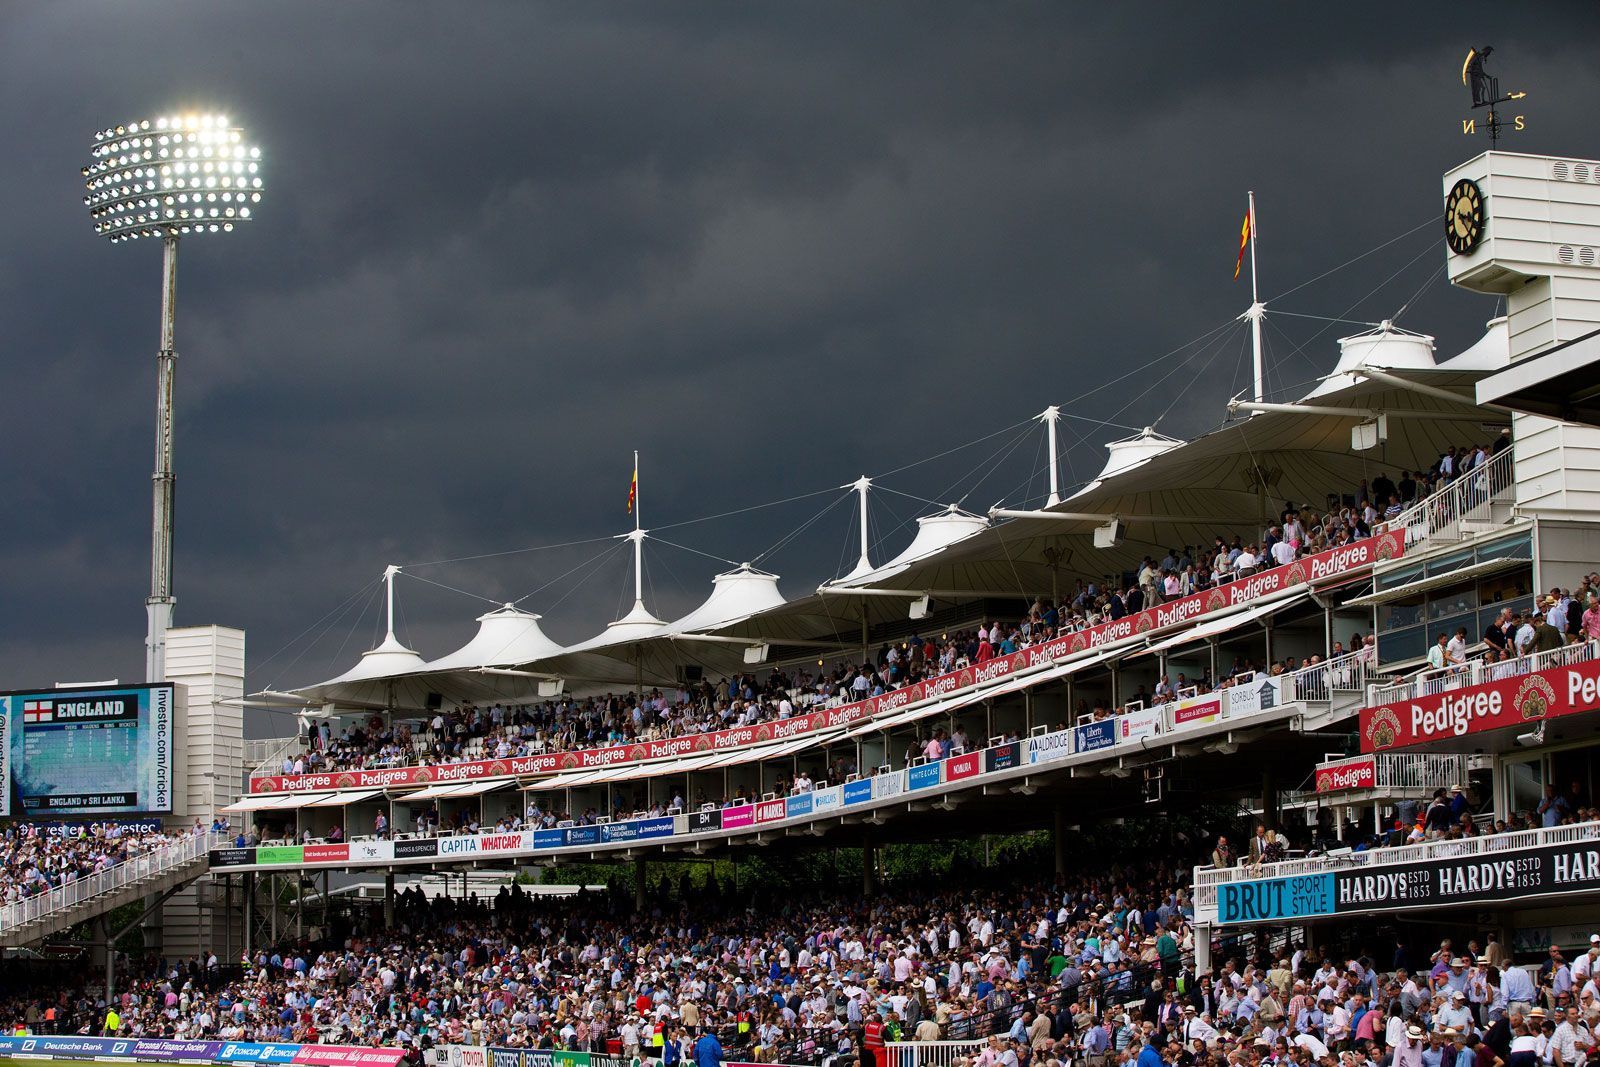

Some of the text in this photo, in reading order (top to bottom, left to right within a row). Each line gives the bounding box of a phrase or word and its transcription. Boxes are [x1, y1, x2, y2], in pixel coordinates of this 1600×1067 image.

[1514, 115, 1524, 131] S
[1311, 546, 1368, 578] Pedigree
[1230, 574, 1279, 606] Pedigree
[1157, 598, 1201, 628] Pedigree
[1090, 621, 1131, 648] Pedigree
[976, 660, 1009, 684] Pedigree
[925, 677, 956, 698] Pedigree
[1567, 670, 1600, 707] Pe
[878, 692, 908, 713] Pedigree
[1231, 689, 1254, 705] SORBUS
[57, 701, 125, 718] ENGLAND
[828, 706, 861, 727] Pedigree
[1411, 690, 1502, 736] Pedigree
[774, 719, 809, 738] Pedigree
[1087, 727, 1102, 738] Liberty
[714, 730, 752, 748] Pedigree
[1038, 733, 1067, 751] ALDRIDGE
[157, 689, 169, 808] Investec.com/cricket
[651, 740, 691, 757] Pedigree
[996, 747, 1011, 758] TESCO
[512, 757, 556, 773] Pedigree
[583, 750, 625, 766] Pedigree
[438, 765, 483, 781] Pedigree
[911, 770, 924, 779] WHITE
[927, 767, 938, 776] CASE
[953, 762, 972, 775] NOMURA
[1333, 766, 1372, 787] Pedigree
[282, 776, 330, 791] Pedigree
[361, 771, 407, 786] Pedigree
[49, 798, 82, 806] ENGLAND
[700, 814, 710, 824] BM
[763, 803, 784, 820] MARKEL
[572, 830, 595, 839] SilverDoor
[610, 829, 637, 837] THREADNEEDLE
[657, 823, 673, 831] Perpetual
[367, 847, 377, 857] bgc
[441, 838, 477, 854] CAPITA
[1516, 857, 1541, 872] ESTD
[1291, 875, 1327, 895] SPORT
[1408, 870, 1430, 884] ESTD
[1438, 860, 1516, 896] HARDYS
[1517, 873, 1541, 888] 1853
[1339, 873, 1407, 904] HARDYS
[1408, 884, 1430, 898] 1853
[1224, 880, 1286, 921] BRUT
[1291, 894, 1328, 915] STYLE
[44, 1042, 103, 1052] Deutsche Bank
[135, 1041, 207, 1053] Personal Finance Society
[234, 1048, 260, 1056] CONCUR
[271, 1049, 298, 1058] CONCUR
[463, 1051, 484, 1066] TOYOTA
[494, 1052, 519, 1067] FOSTER'S
[526, 1053, 552, 1067] FOSTER'S
